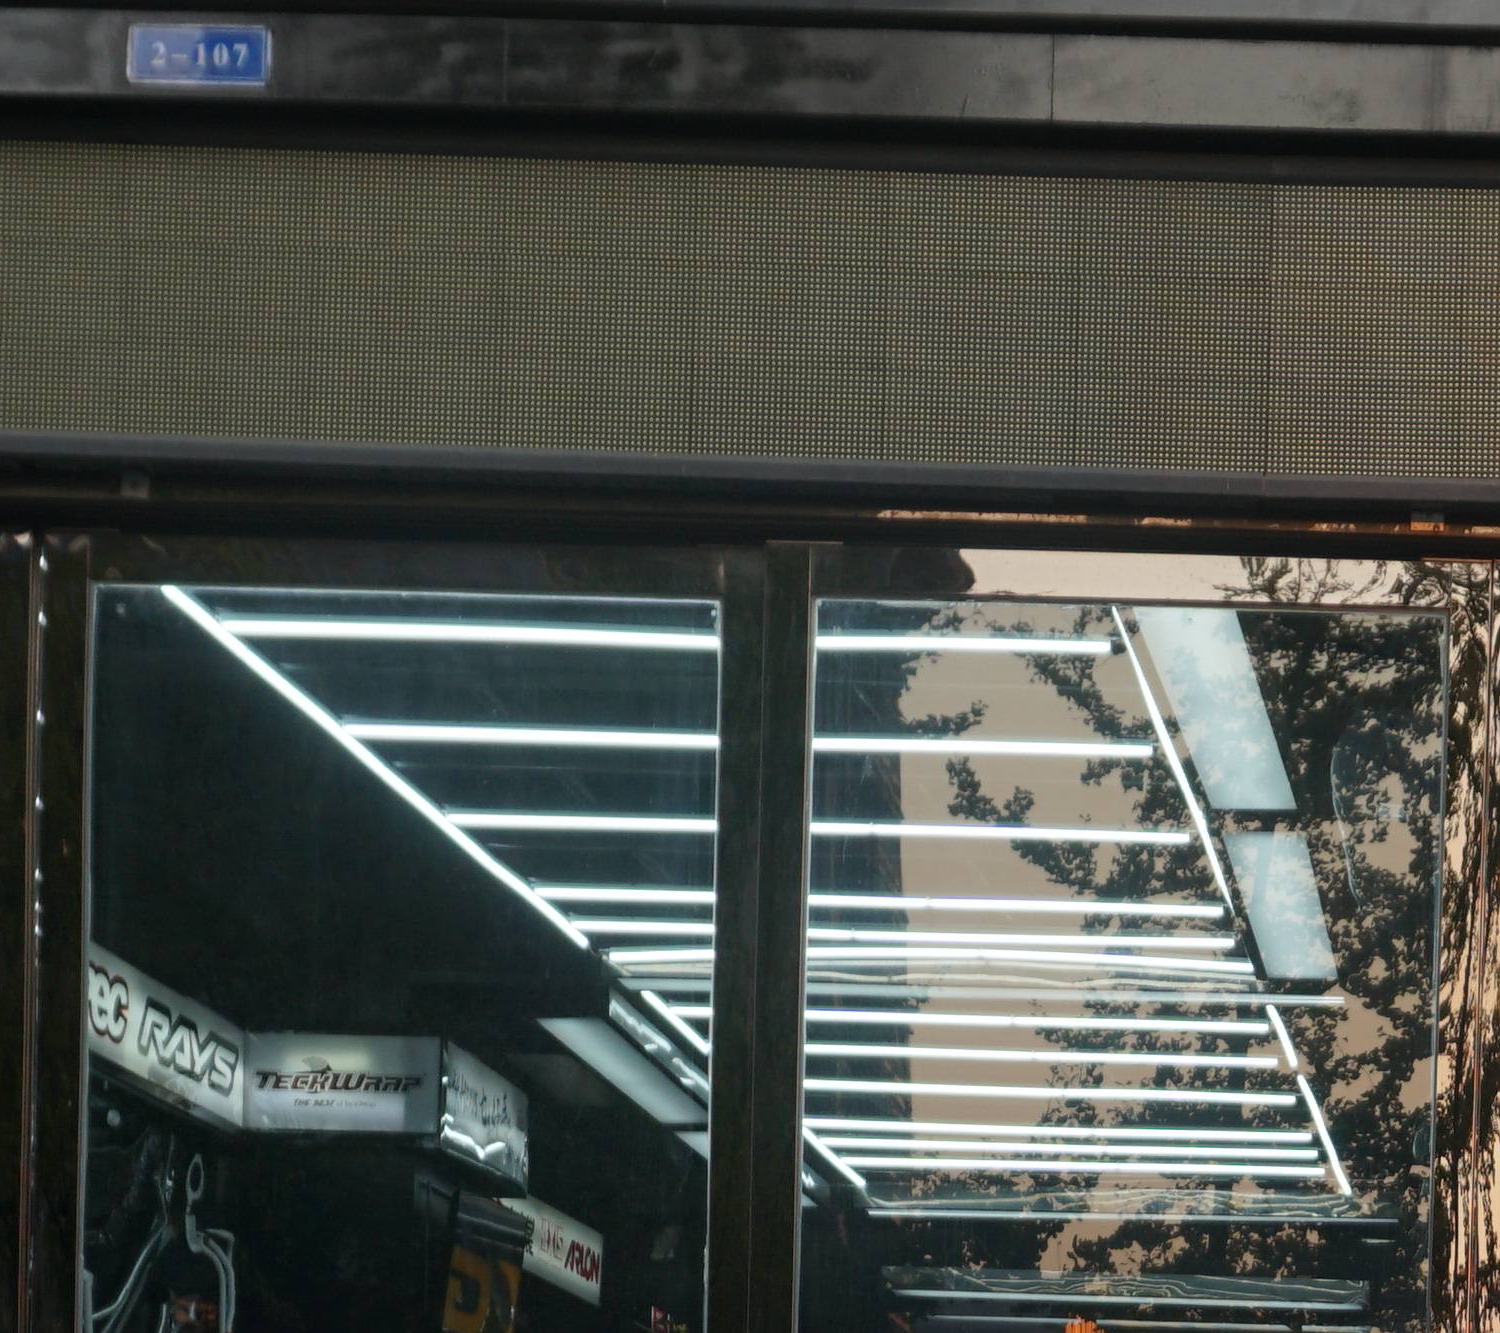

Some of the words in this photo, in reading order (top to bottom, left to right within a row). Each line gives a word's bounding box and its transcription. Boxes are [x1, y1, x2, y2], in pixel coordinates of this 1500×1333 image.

[151, 41, 249, 66] 2-107
[138, 996, 239, 1097] RAYS
[564, 1240, 600, 1284] ARLON
